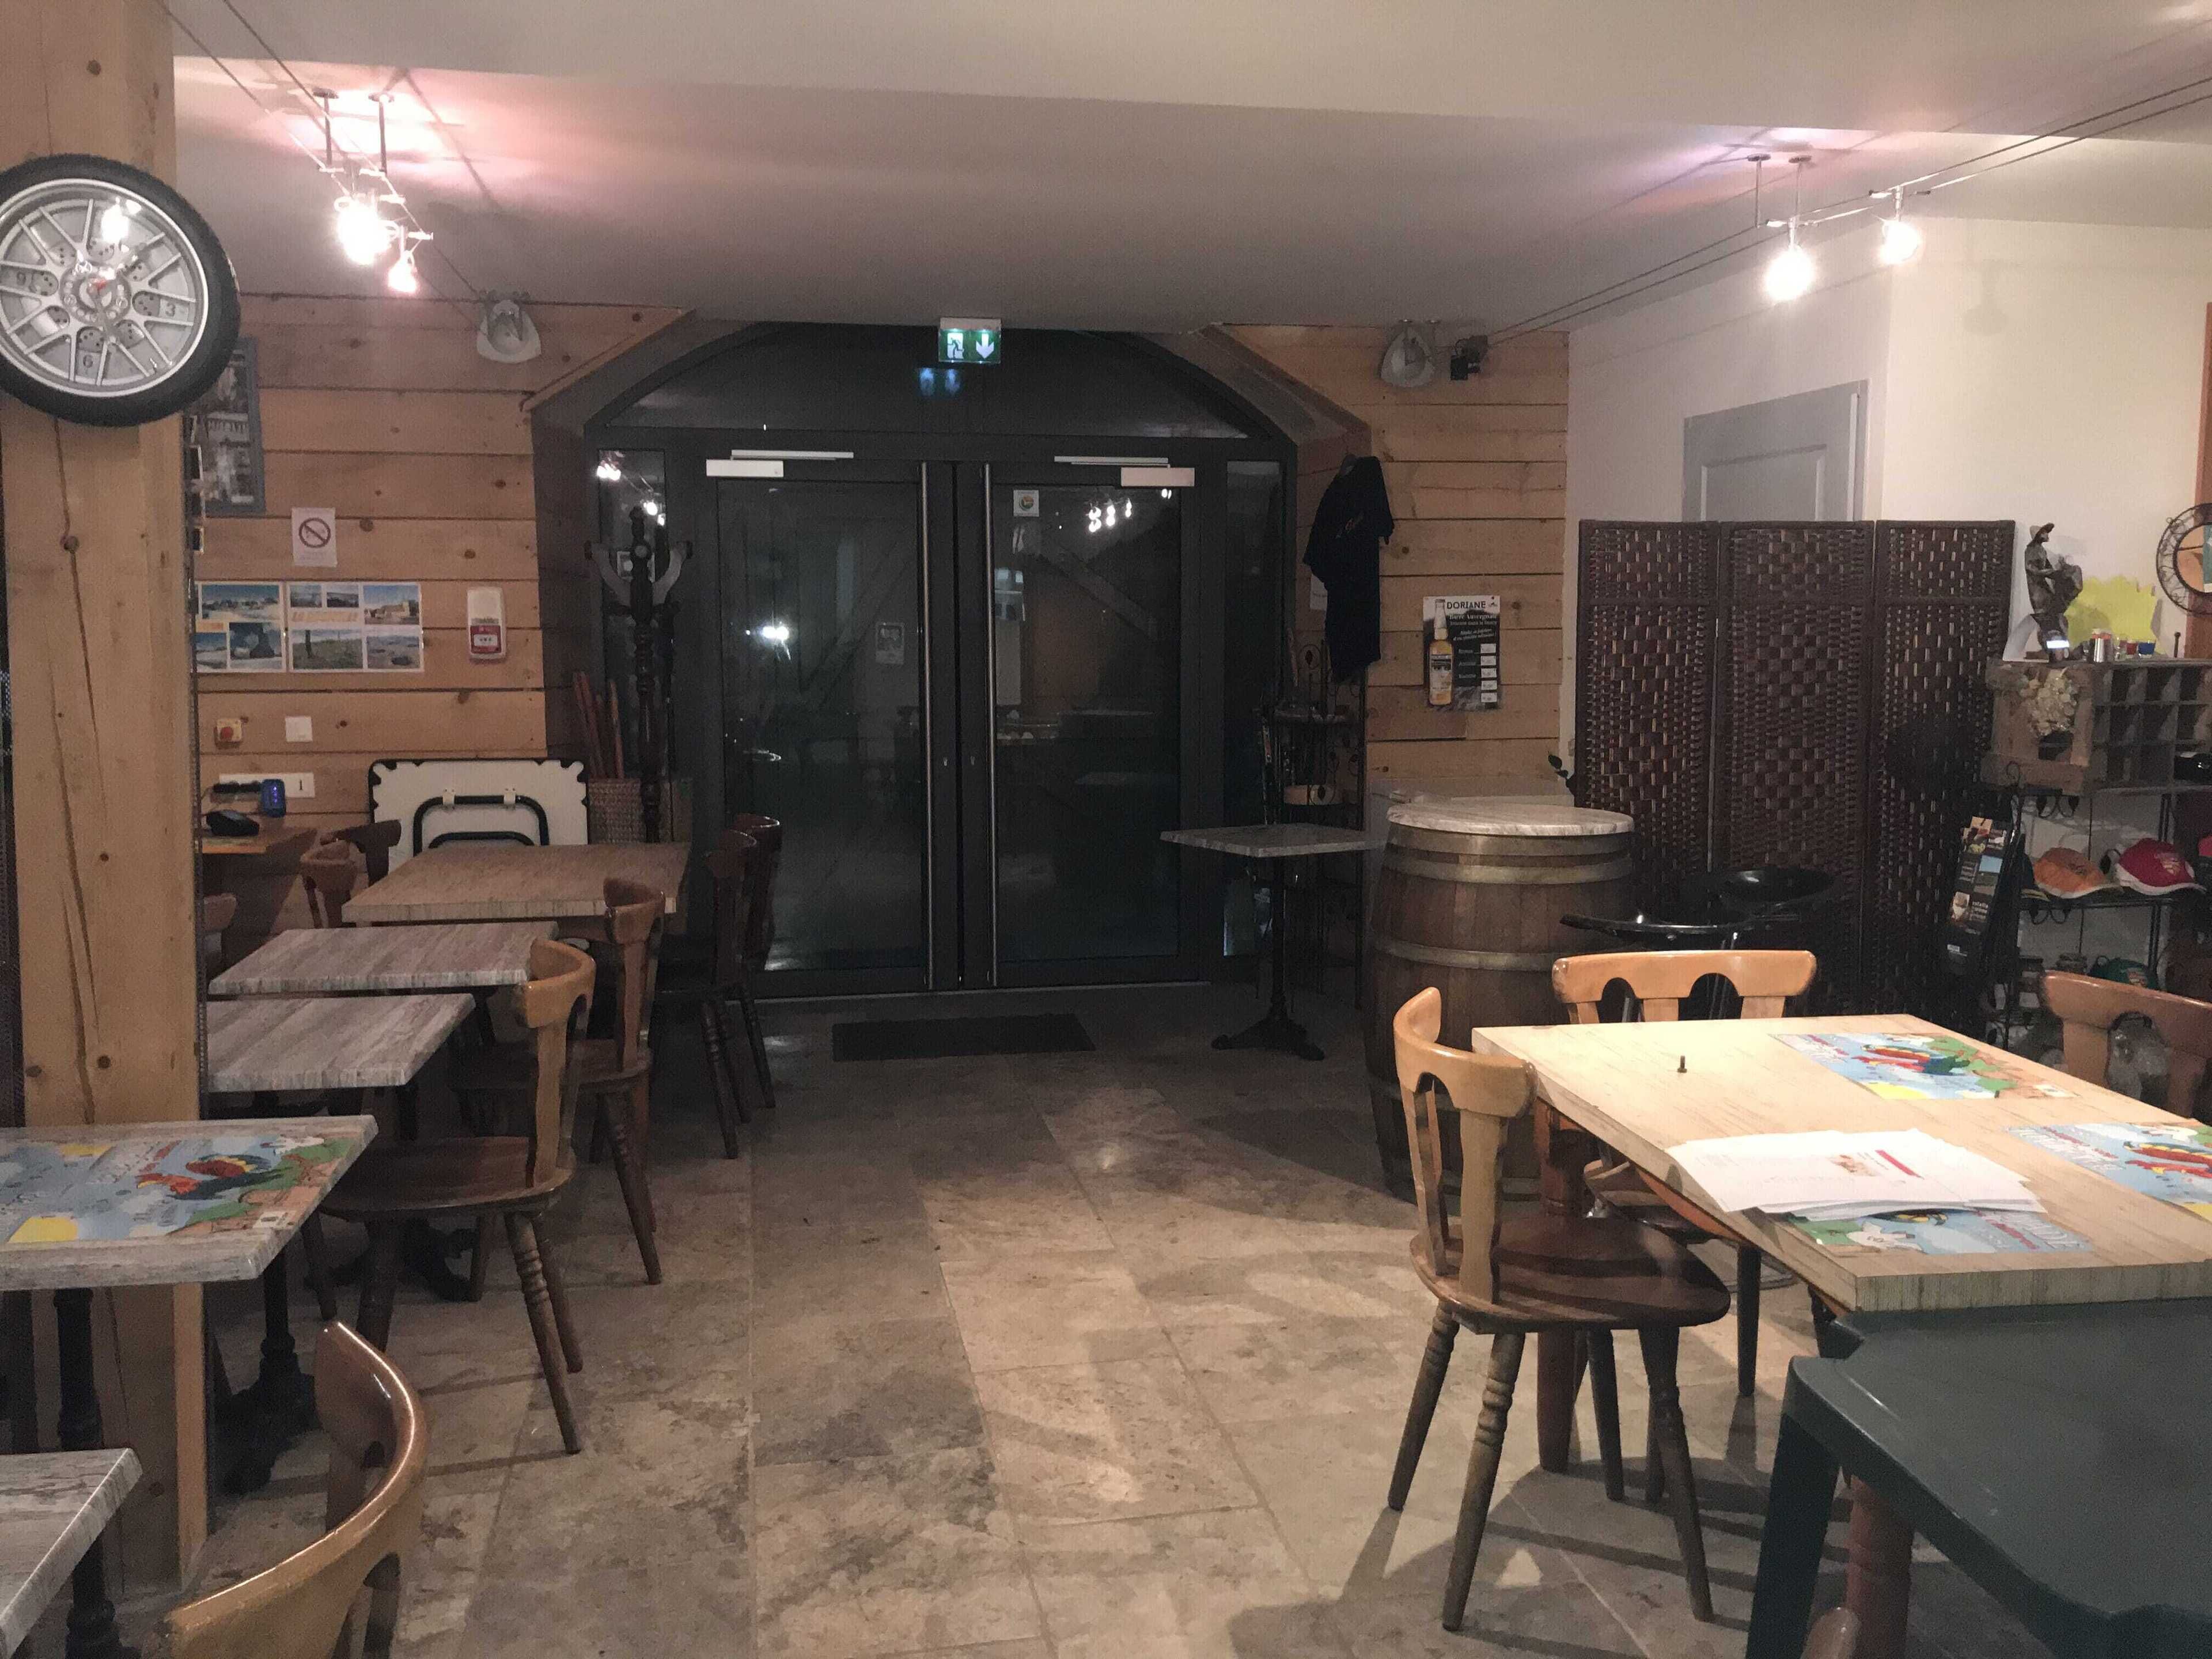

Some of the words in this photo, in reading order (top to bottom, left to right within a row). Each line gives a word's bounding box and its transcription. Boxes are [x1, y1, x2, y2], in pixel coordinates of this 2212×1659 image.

[165, 303, 176, 316] 3
[83, 355, 93, 368] 6
[1447, 601, 1486, 609] DORIANE
